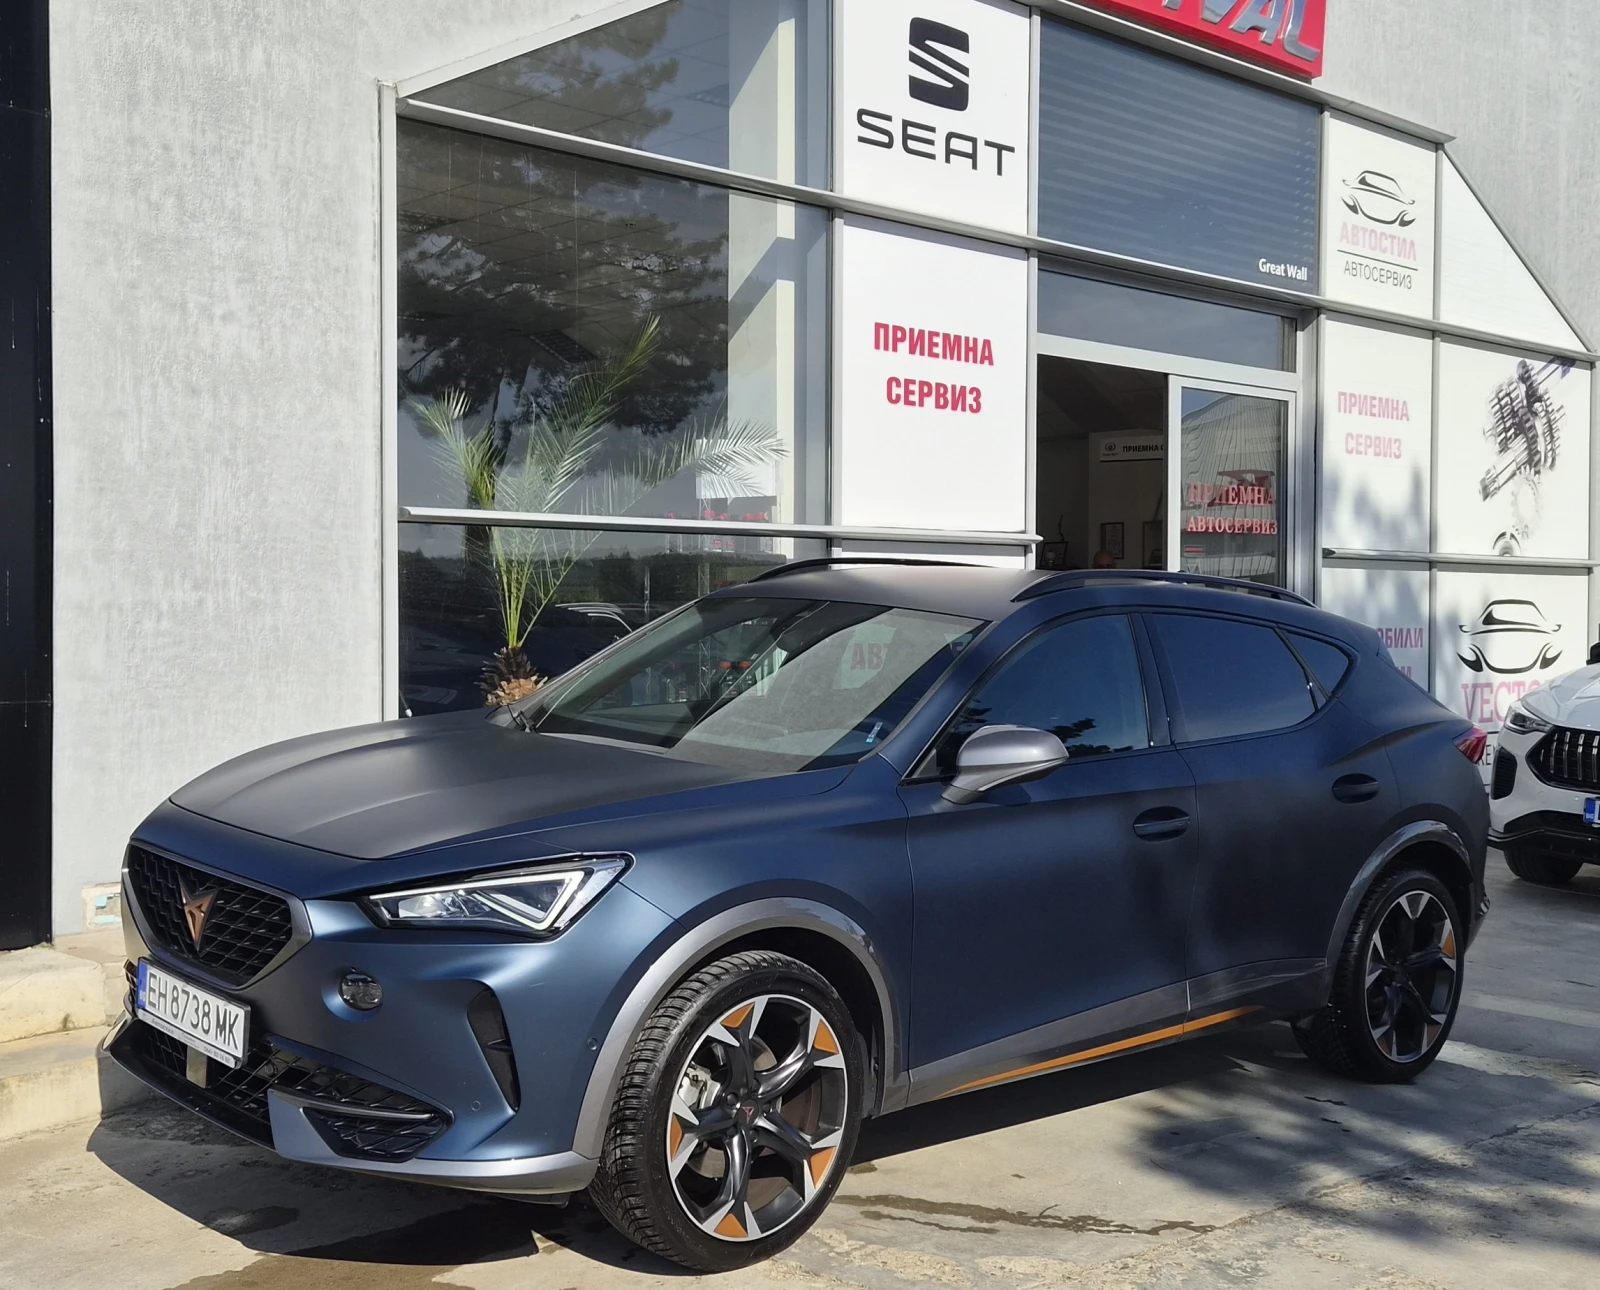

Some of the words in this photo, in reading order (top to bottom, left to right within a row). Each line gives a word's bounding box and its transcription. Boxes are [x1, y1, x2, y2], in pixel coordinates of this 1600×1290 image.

[857, 108, 1015, 176] SEAT
[1340, 222, 1417, 261] АВТОСТИЛ
[1259, 258, 1285, 276] Great
[1286, 264, 1307, 280] Wall
[1344, 260, 1412, 289] АВТОСЕРВИЗ
[874, 322, 994, 366] ПРИЕМНА
[886, 376, 982, 414] СЕРВИЗ
[1338, 391, 1410, 422] ПРИЕМНА
[1122, 444, 1159, 453] ПРИЕМНА
[1345, 432, 1402, 460] СЕРВИЗ
[1189, 483, 1276, 506] ПРИЕМНА
[1187, 515, 1278, 535] АВТОСЕРВИЗ
